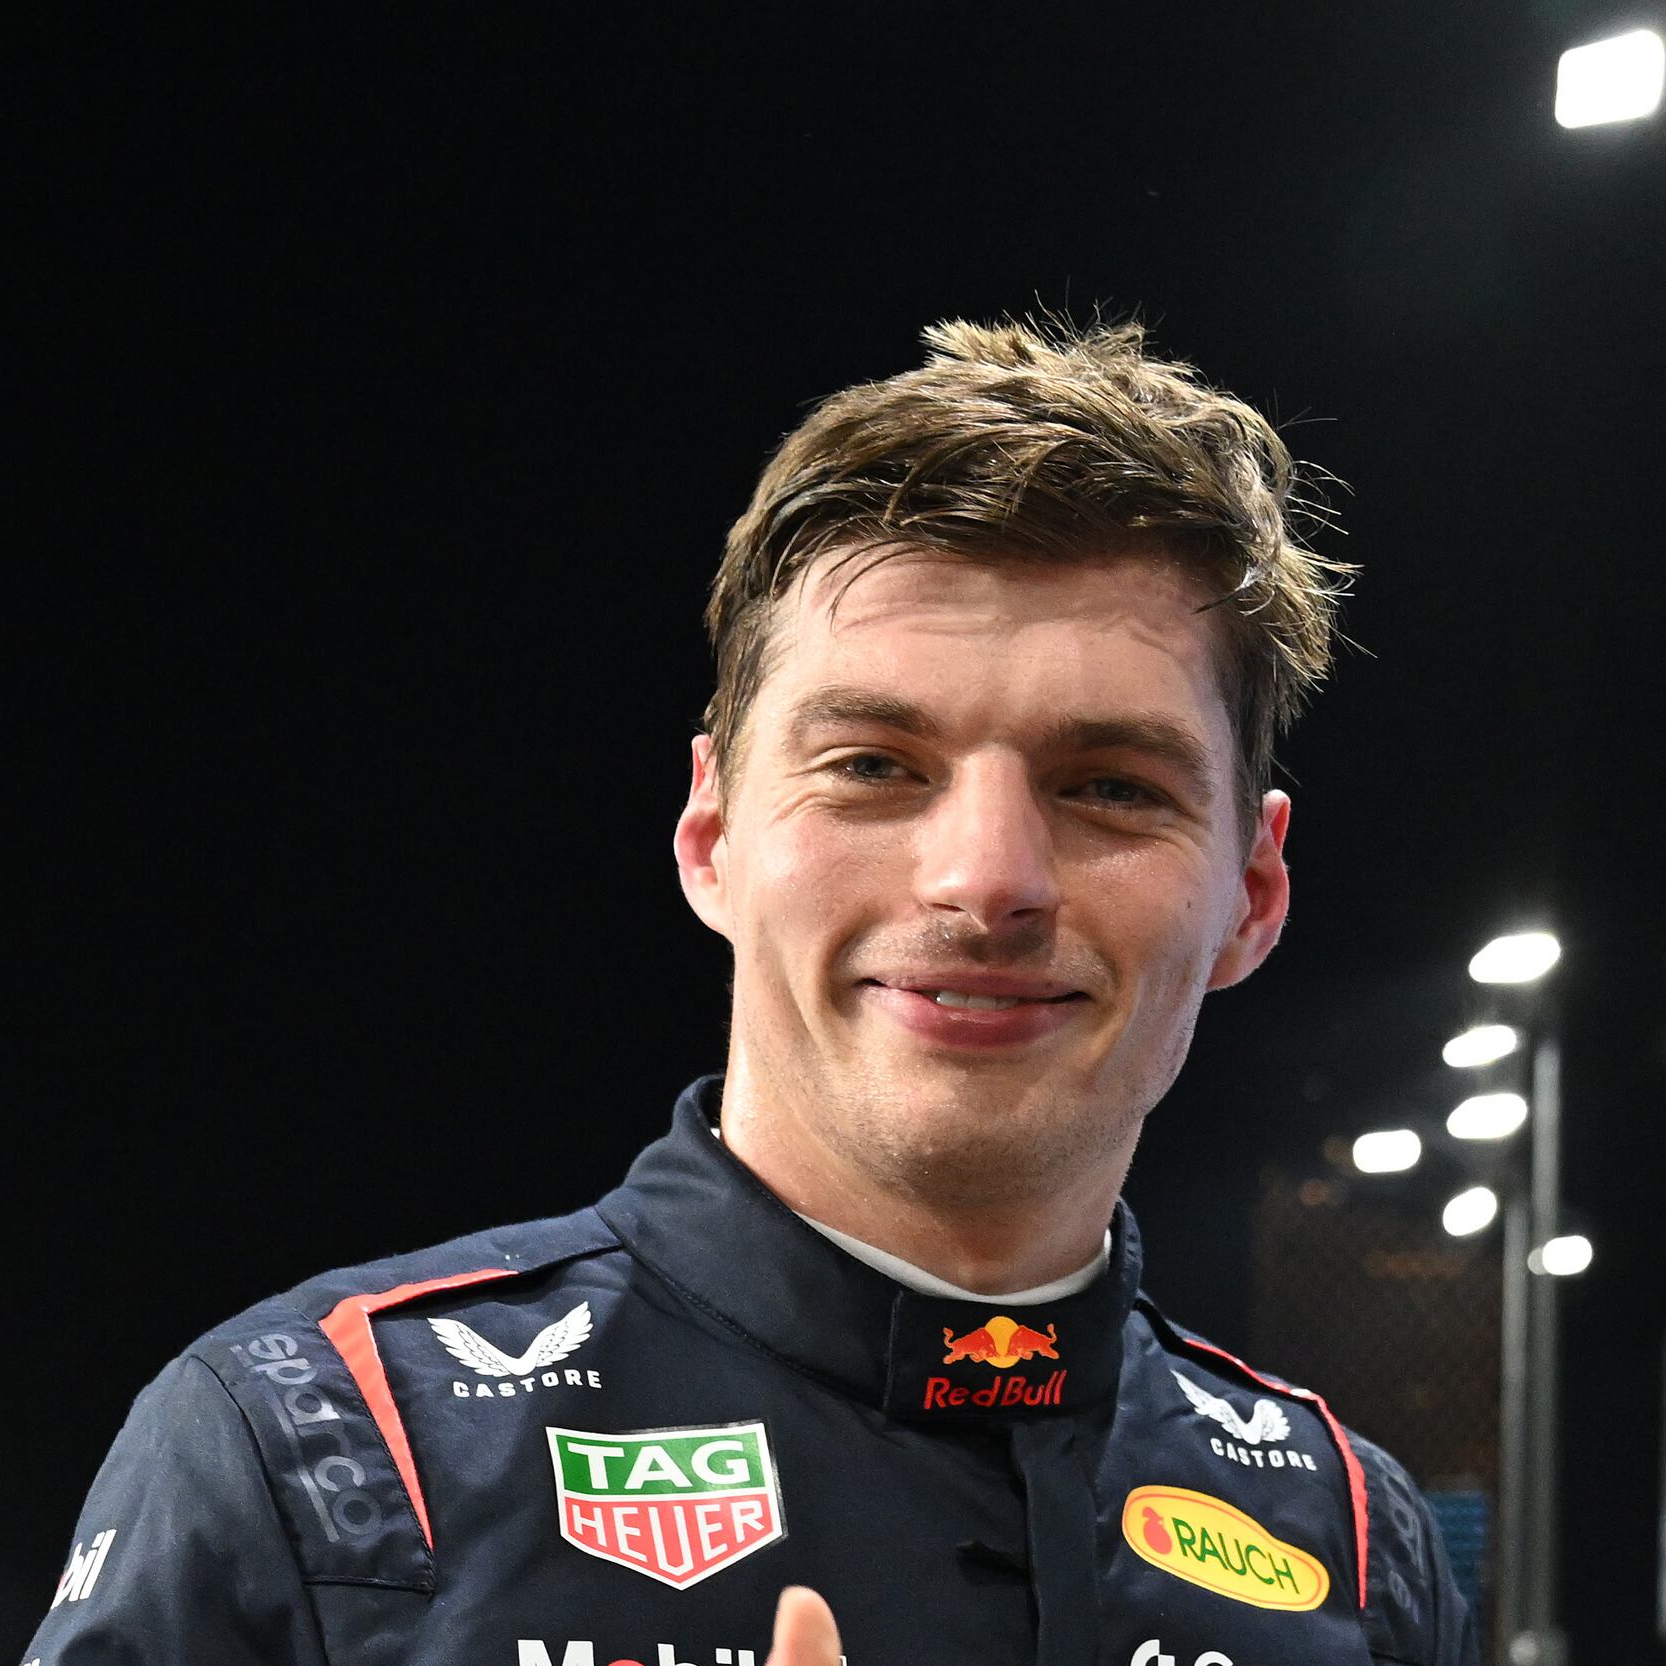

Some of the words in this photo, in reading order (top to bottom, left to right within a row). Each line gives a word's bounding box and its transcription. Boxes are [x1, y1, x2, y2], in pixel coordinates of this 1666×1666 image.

[452, 1368, 603, 1399] CASTORE
[924, 1376, 1002, 1410] Red
[1004, 1369, 1068, 1406] Bull
[567, 1438, 752, 1490] TAG
[1210, 1436, 1318, 1472] CASTORE
[572, 1498, 765, 1578] HEUER
[1172, 1517, 1302, 1596] RAUCH
